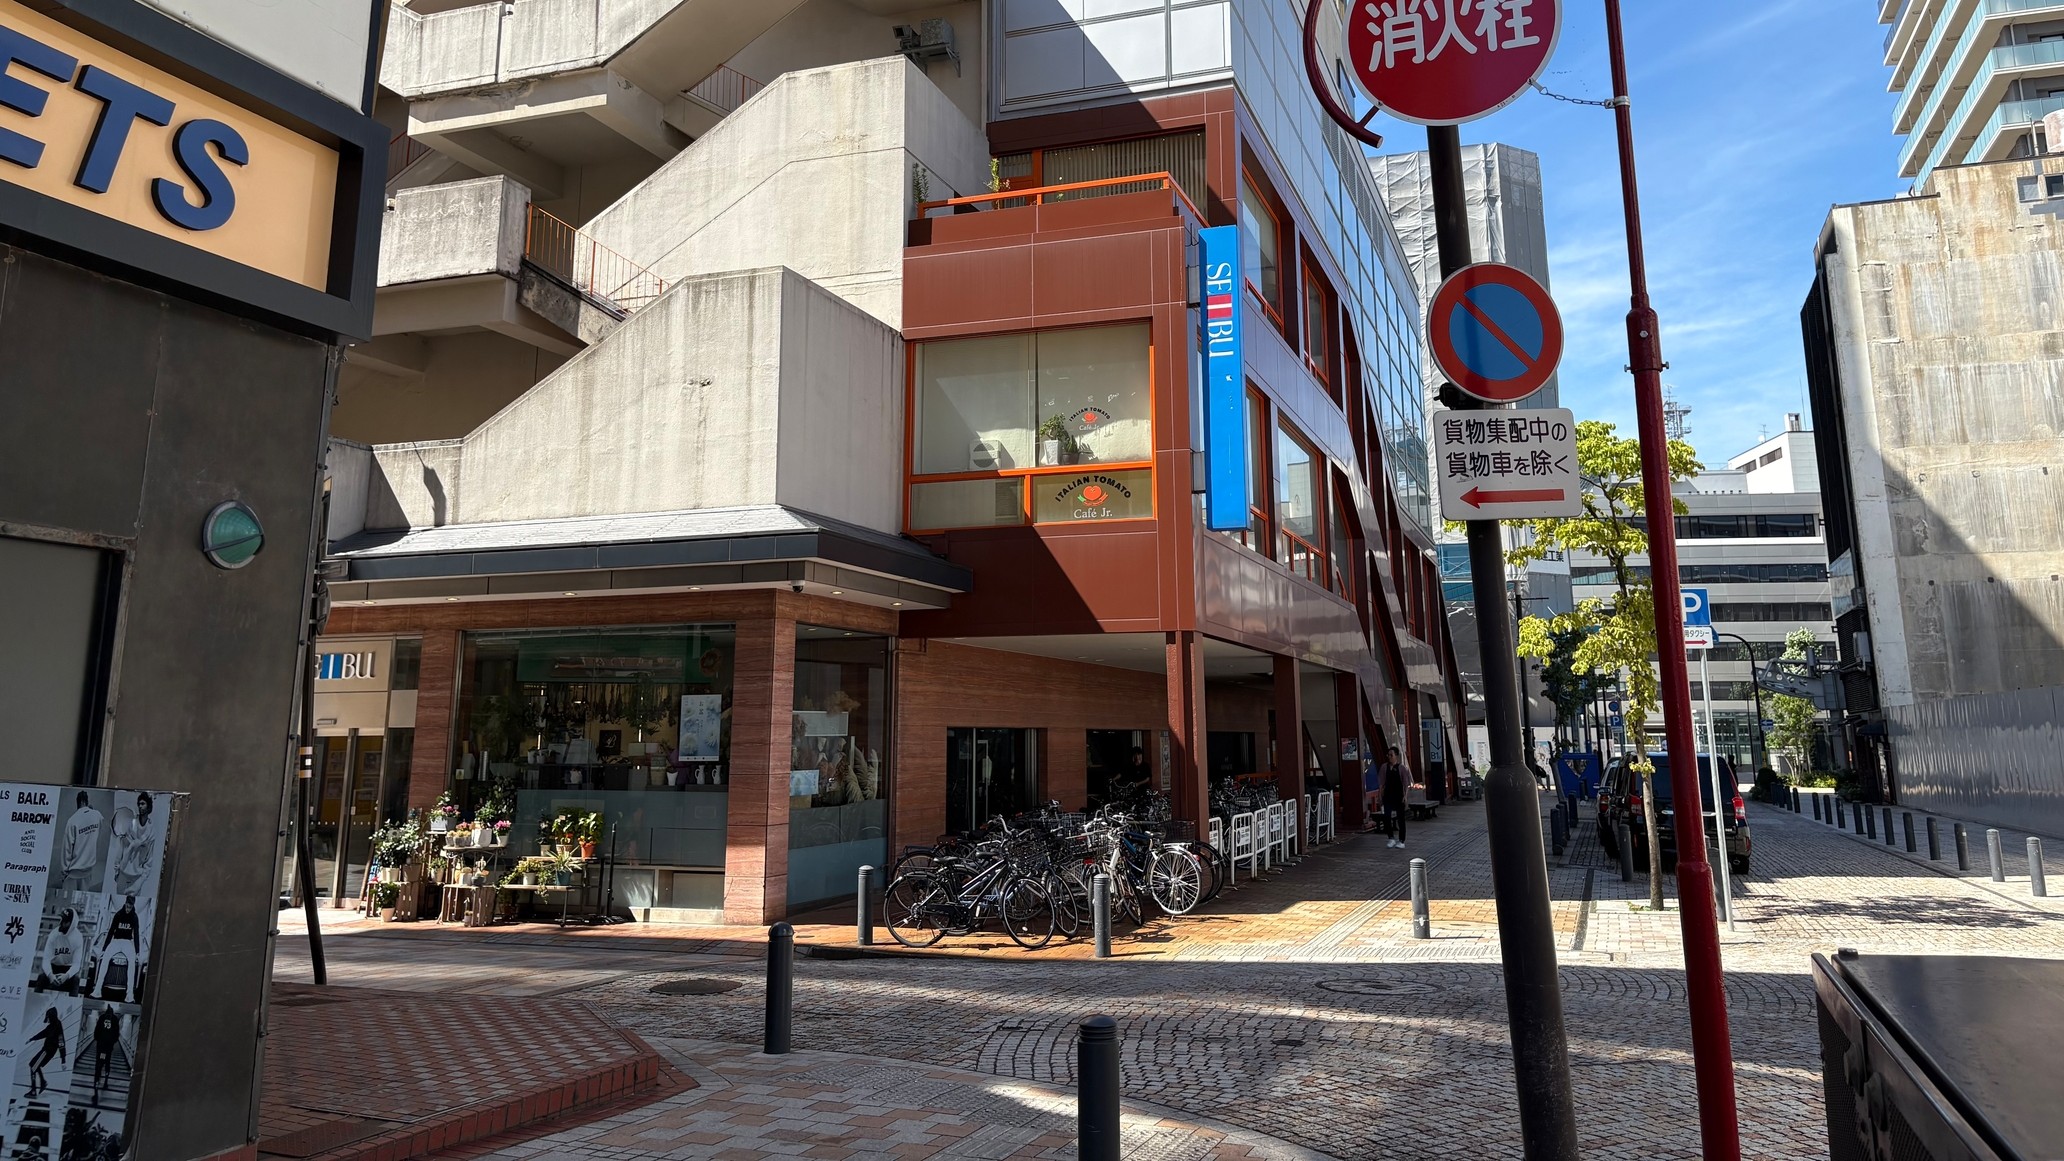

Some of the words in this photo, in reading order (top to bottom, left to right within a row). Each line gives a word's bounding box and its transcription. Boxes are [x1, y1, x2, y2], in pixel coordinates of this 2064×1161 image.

[1366, 0, 1541, 72] 消火栓
[1068, 407, 1089, 422] ITALIAN
[1090, 406, 1111, 420] TOMATO
[1443, 416, 1568, 445] 貨物集配中の
[1446, 450, 1570, 478] 貨物車を除く
[1055, 475, 1090, 502] ITALIAN
[1093, 475, 1132, 499] TOMATO
[1073, 508, 1097, 519] Café
[1101, 507, 1113, 518] Jr.
[1680, 592, 1702, 623] P
[1612, 716, 1620, 726] P
[17, 791, 49, 806] BALR.
[11, 811, 52, 825] BARROW
[4, 861, 47, 874] Paragraph
[3, 883, 32, 895] URBAN
[13, 893, 31, 903] SUN
